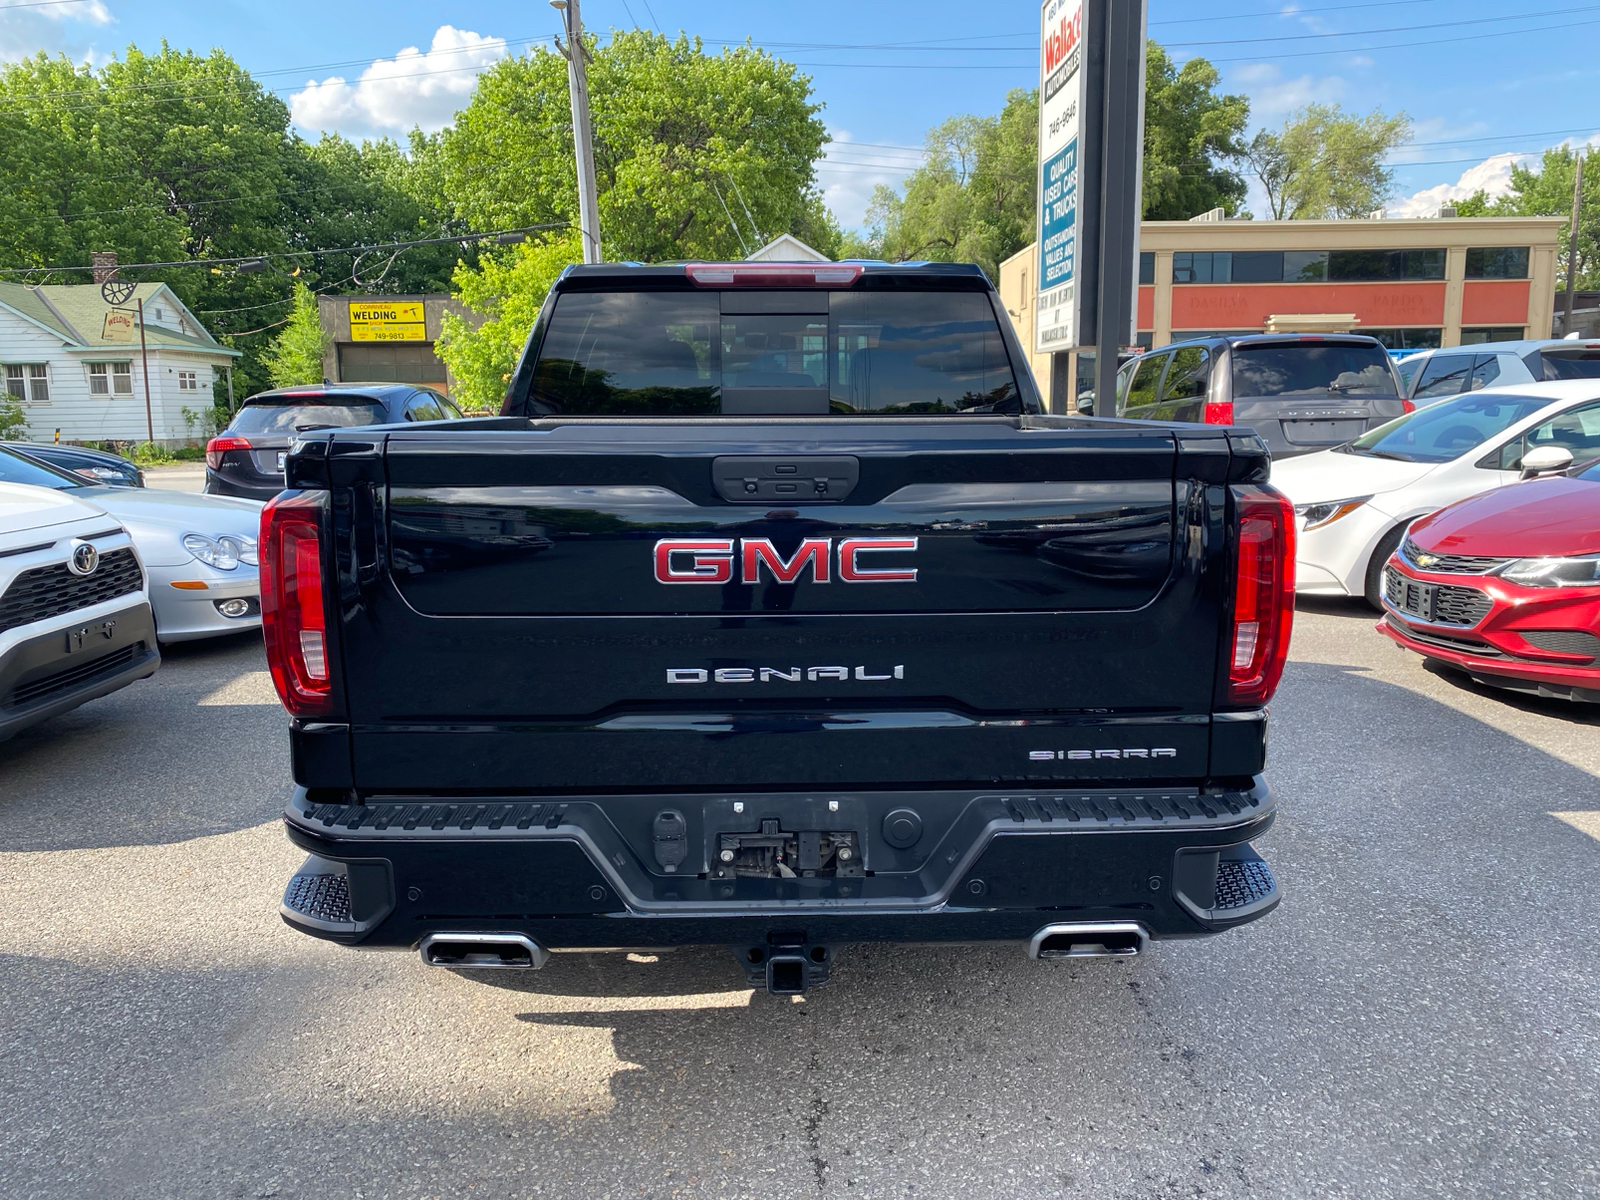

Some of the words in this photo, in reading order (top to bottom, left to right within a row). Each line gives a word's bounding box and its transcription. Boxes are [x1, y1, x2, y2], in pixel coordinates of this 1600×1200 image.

[1045, 4, 1081, 75] Wallace
[1046, 47, 1080, 98] AUTOMOBILES
[1049, 100, 1076, 139] 746-9646
[1051, 149, 1074, 182] QUALITY
[1045, 181, 1061, 205] USED
[1064, 167, 1077, 193] CARS
[1044, 208, 1050, 226] &
[1053, 189, 1076, 221] TRUCKS
[1045, 223, 1074, 252] OUTSTANDING
[1045, 247, 1063, 266] VALUES
[1064, 241, 1073, 258] AND
[1047, 258, 1071, 281] SELECTION
[108, 316, 131, 327] WELDING
[353, 311, 397, 320] WELDING
[653, 536, 919, 584] GMC
[666, 664, 904, 683] DENALI
[1029, 748, 1177, 760] SIERRA
